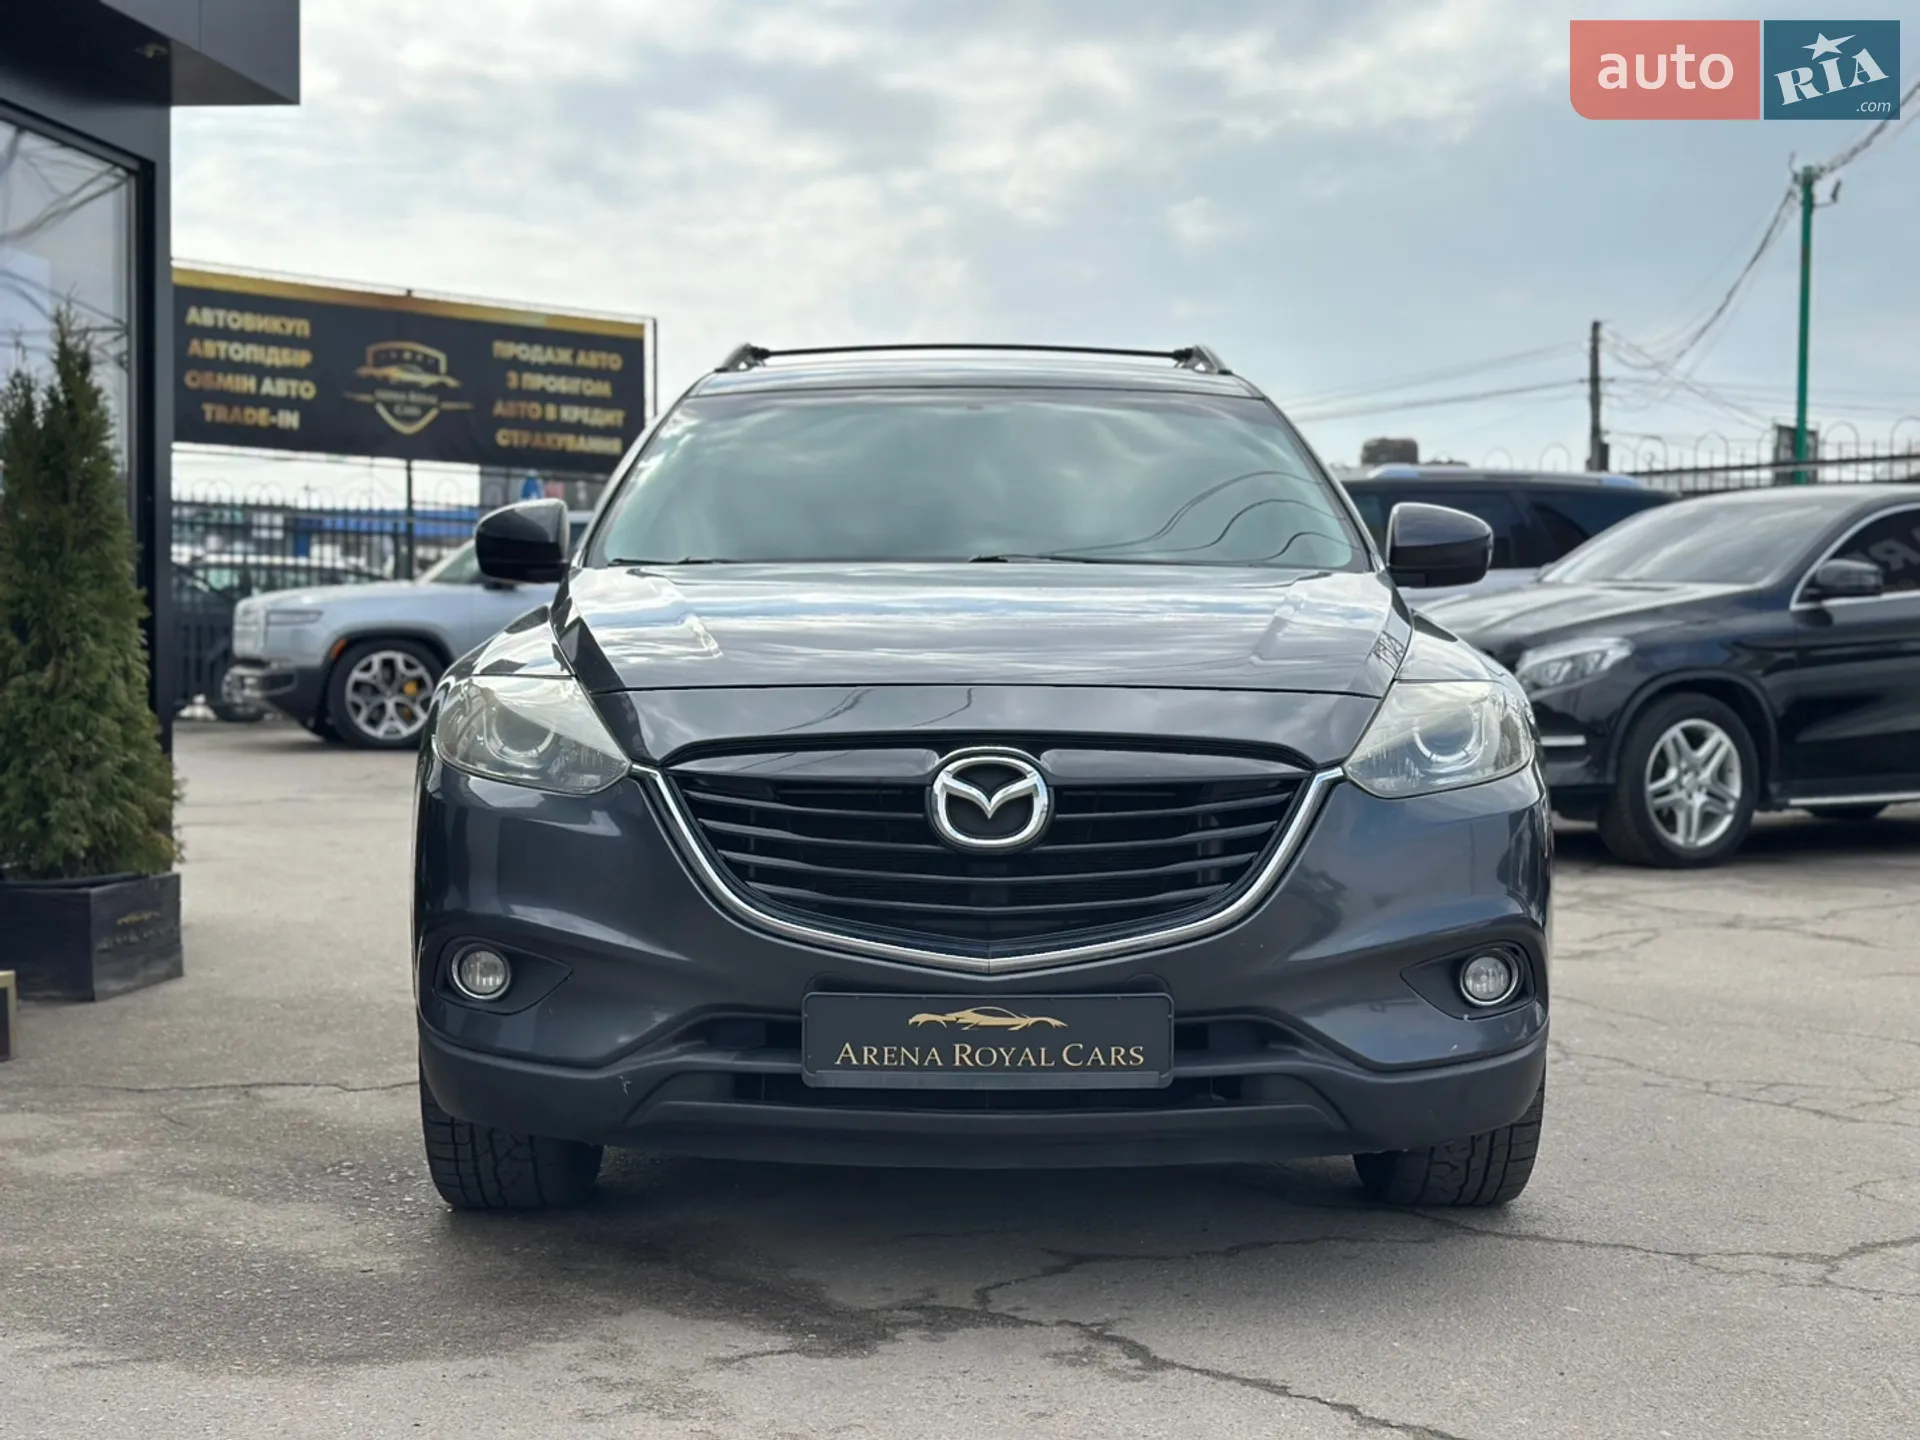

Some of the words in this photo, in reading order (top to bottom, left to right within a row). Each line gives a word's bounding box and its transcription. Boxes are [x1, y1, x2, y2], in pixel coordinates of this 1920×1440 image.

[186, 305, 311, 338] АВТОВИКУП
[492, 340, 574, 366] ПРОДАЖ
[575, 348, 623, 371] АВТО
[259, 376, 317, 400] АВТО
[201, 402, 300, 430] TRADE-IN
[493, 399, 541, 420] АВТО
[834, 1042, 943, 1067] ARENA
[953, 1043, 1055, 1067] ROYAL
[1061, 1043, 1145, 1067] CARS
